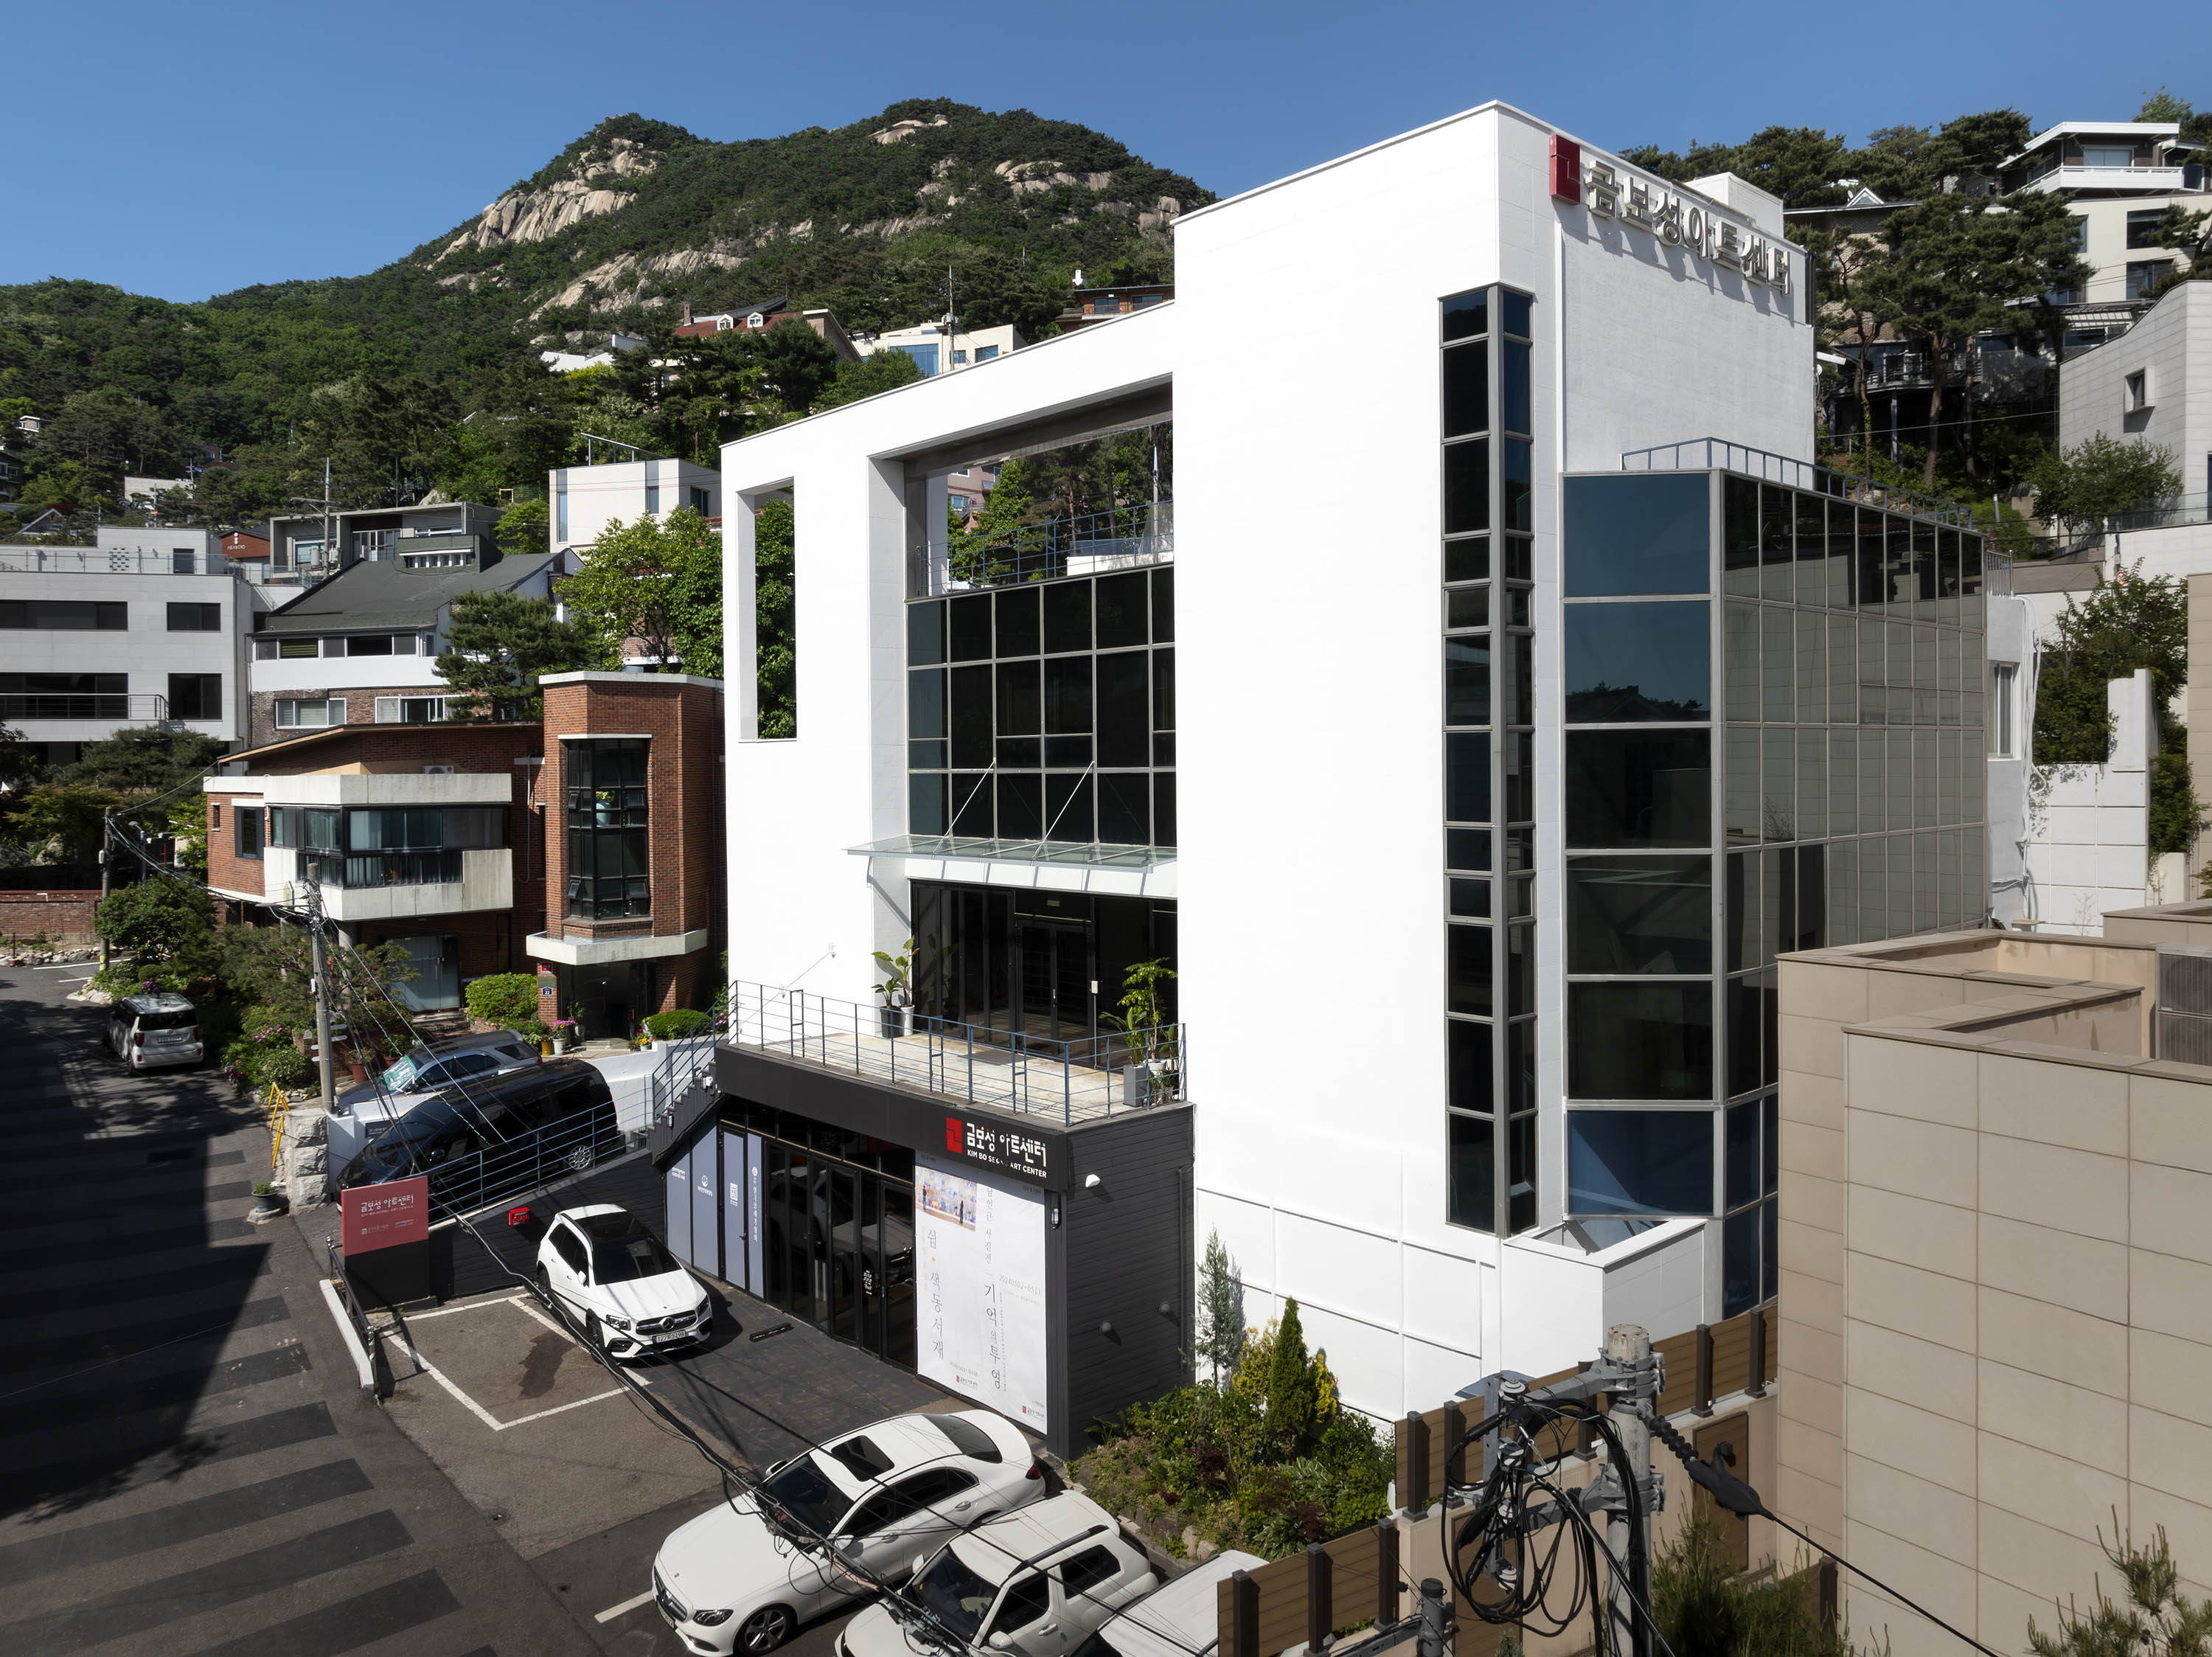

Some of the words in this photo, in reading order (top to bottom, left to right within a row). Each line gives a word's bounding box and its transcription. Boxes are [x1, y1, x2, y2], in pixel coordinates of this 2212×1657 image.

[1585, 160, 1791, 296] 금보성아트센터
[967, 1122, 995, 1153] 금보성
[999, 1133, 1047, 1167] 아트센터
[967, 1150, 978, 1158] KIM
[978, 1153, 987, 1161] BO
[1010, 1161, 1021, 1171] ART
[1023, 1165, 1047, 1178] CENTER
[361, 1200, 381, 1213] 금보성
[383, 1195, 414, 1208] 아트센터
